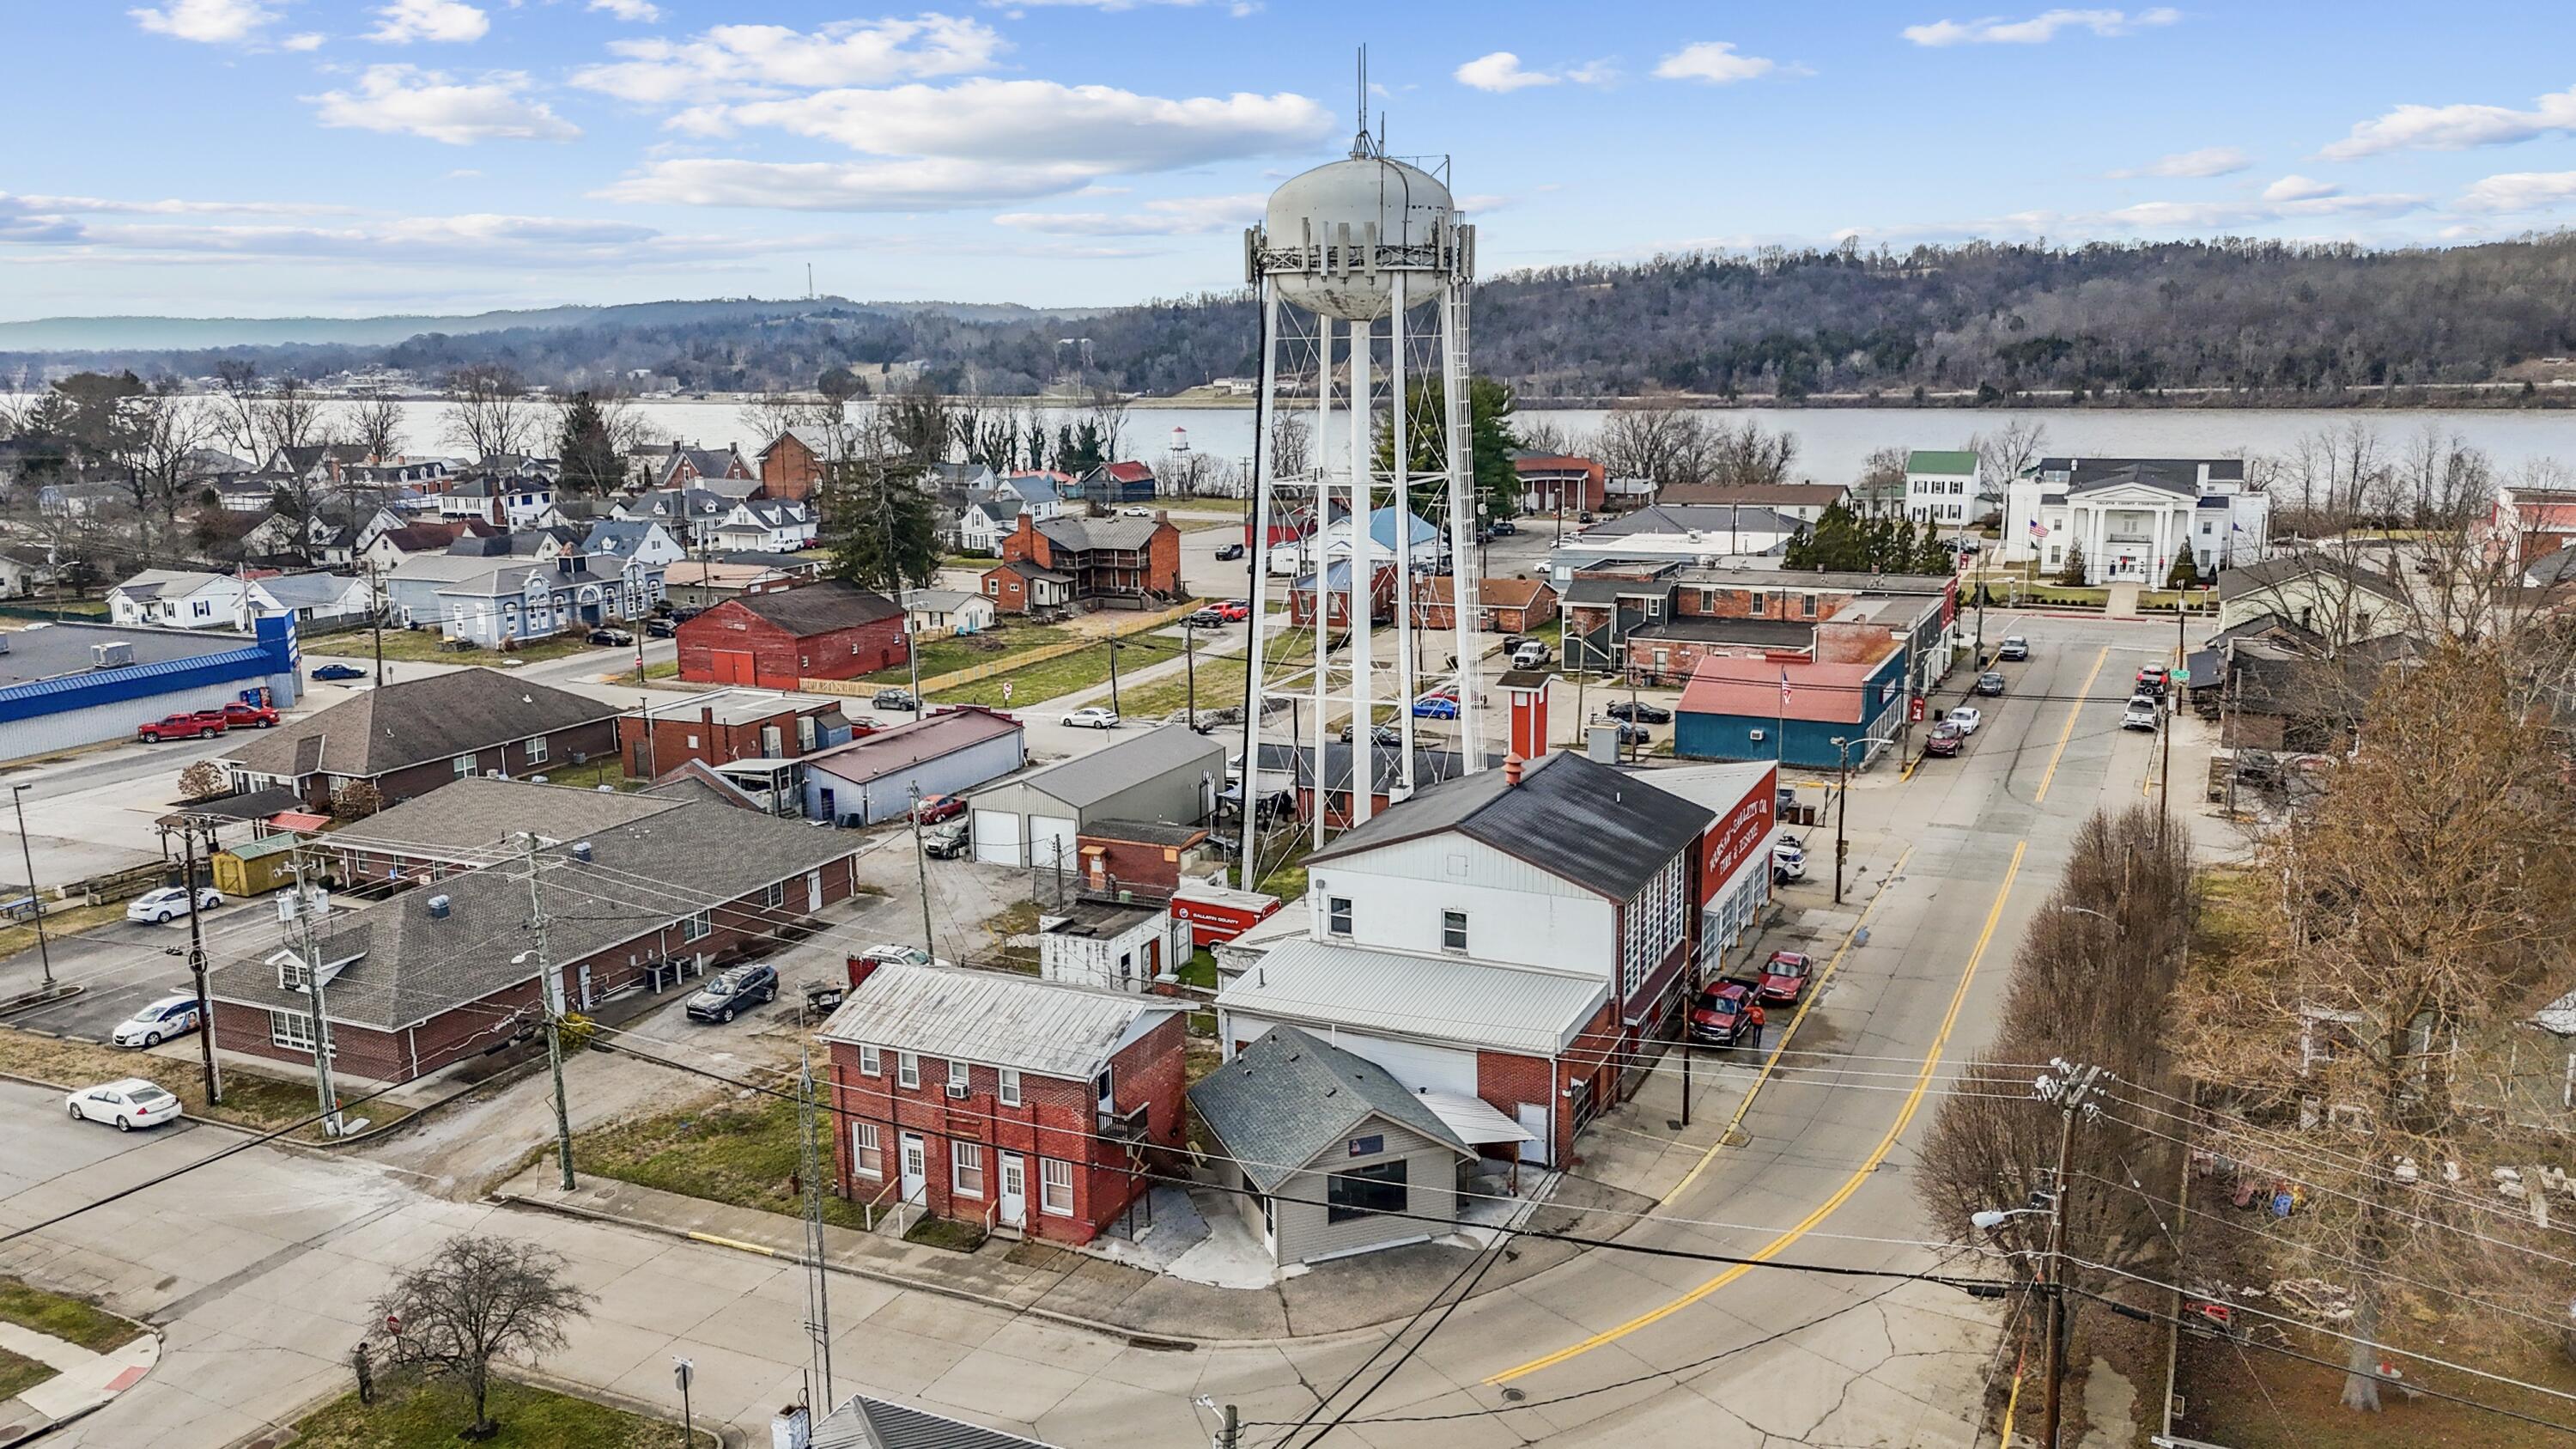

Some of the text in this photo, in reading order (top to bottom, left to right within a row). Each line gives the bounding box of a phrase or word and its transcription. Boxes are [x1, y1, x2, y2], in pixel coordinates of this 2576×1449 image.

[1719, 821, 1759, 875] FIRE & RESCUE
